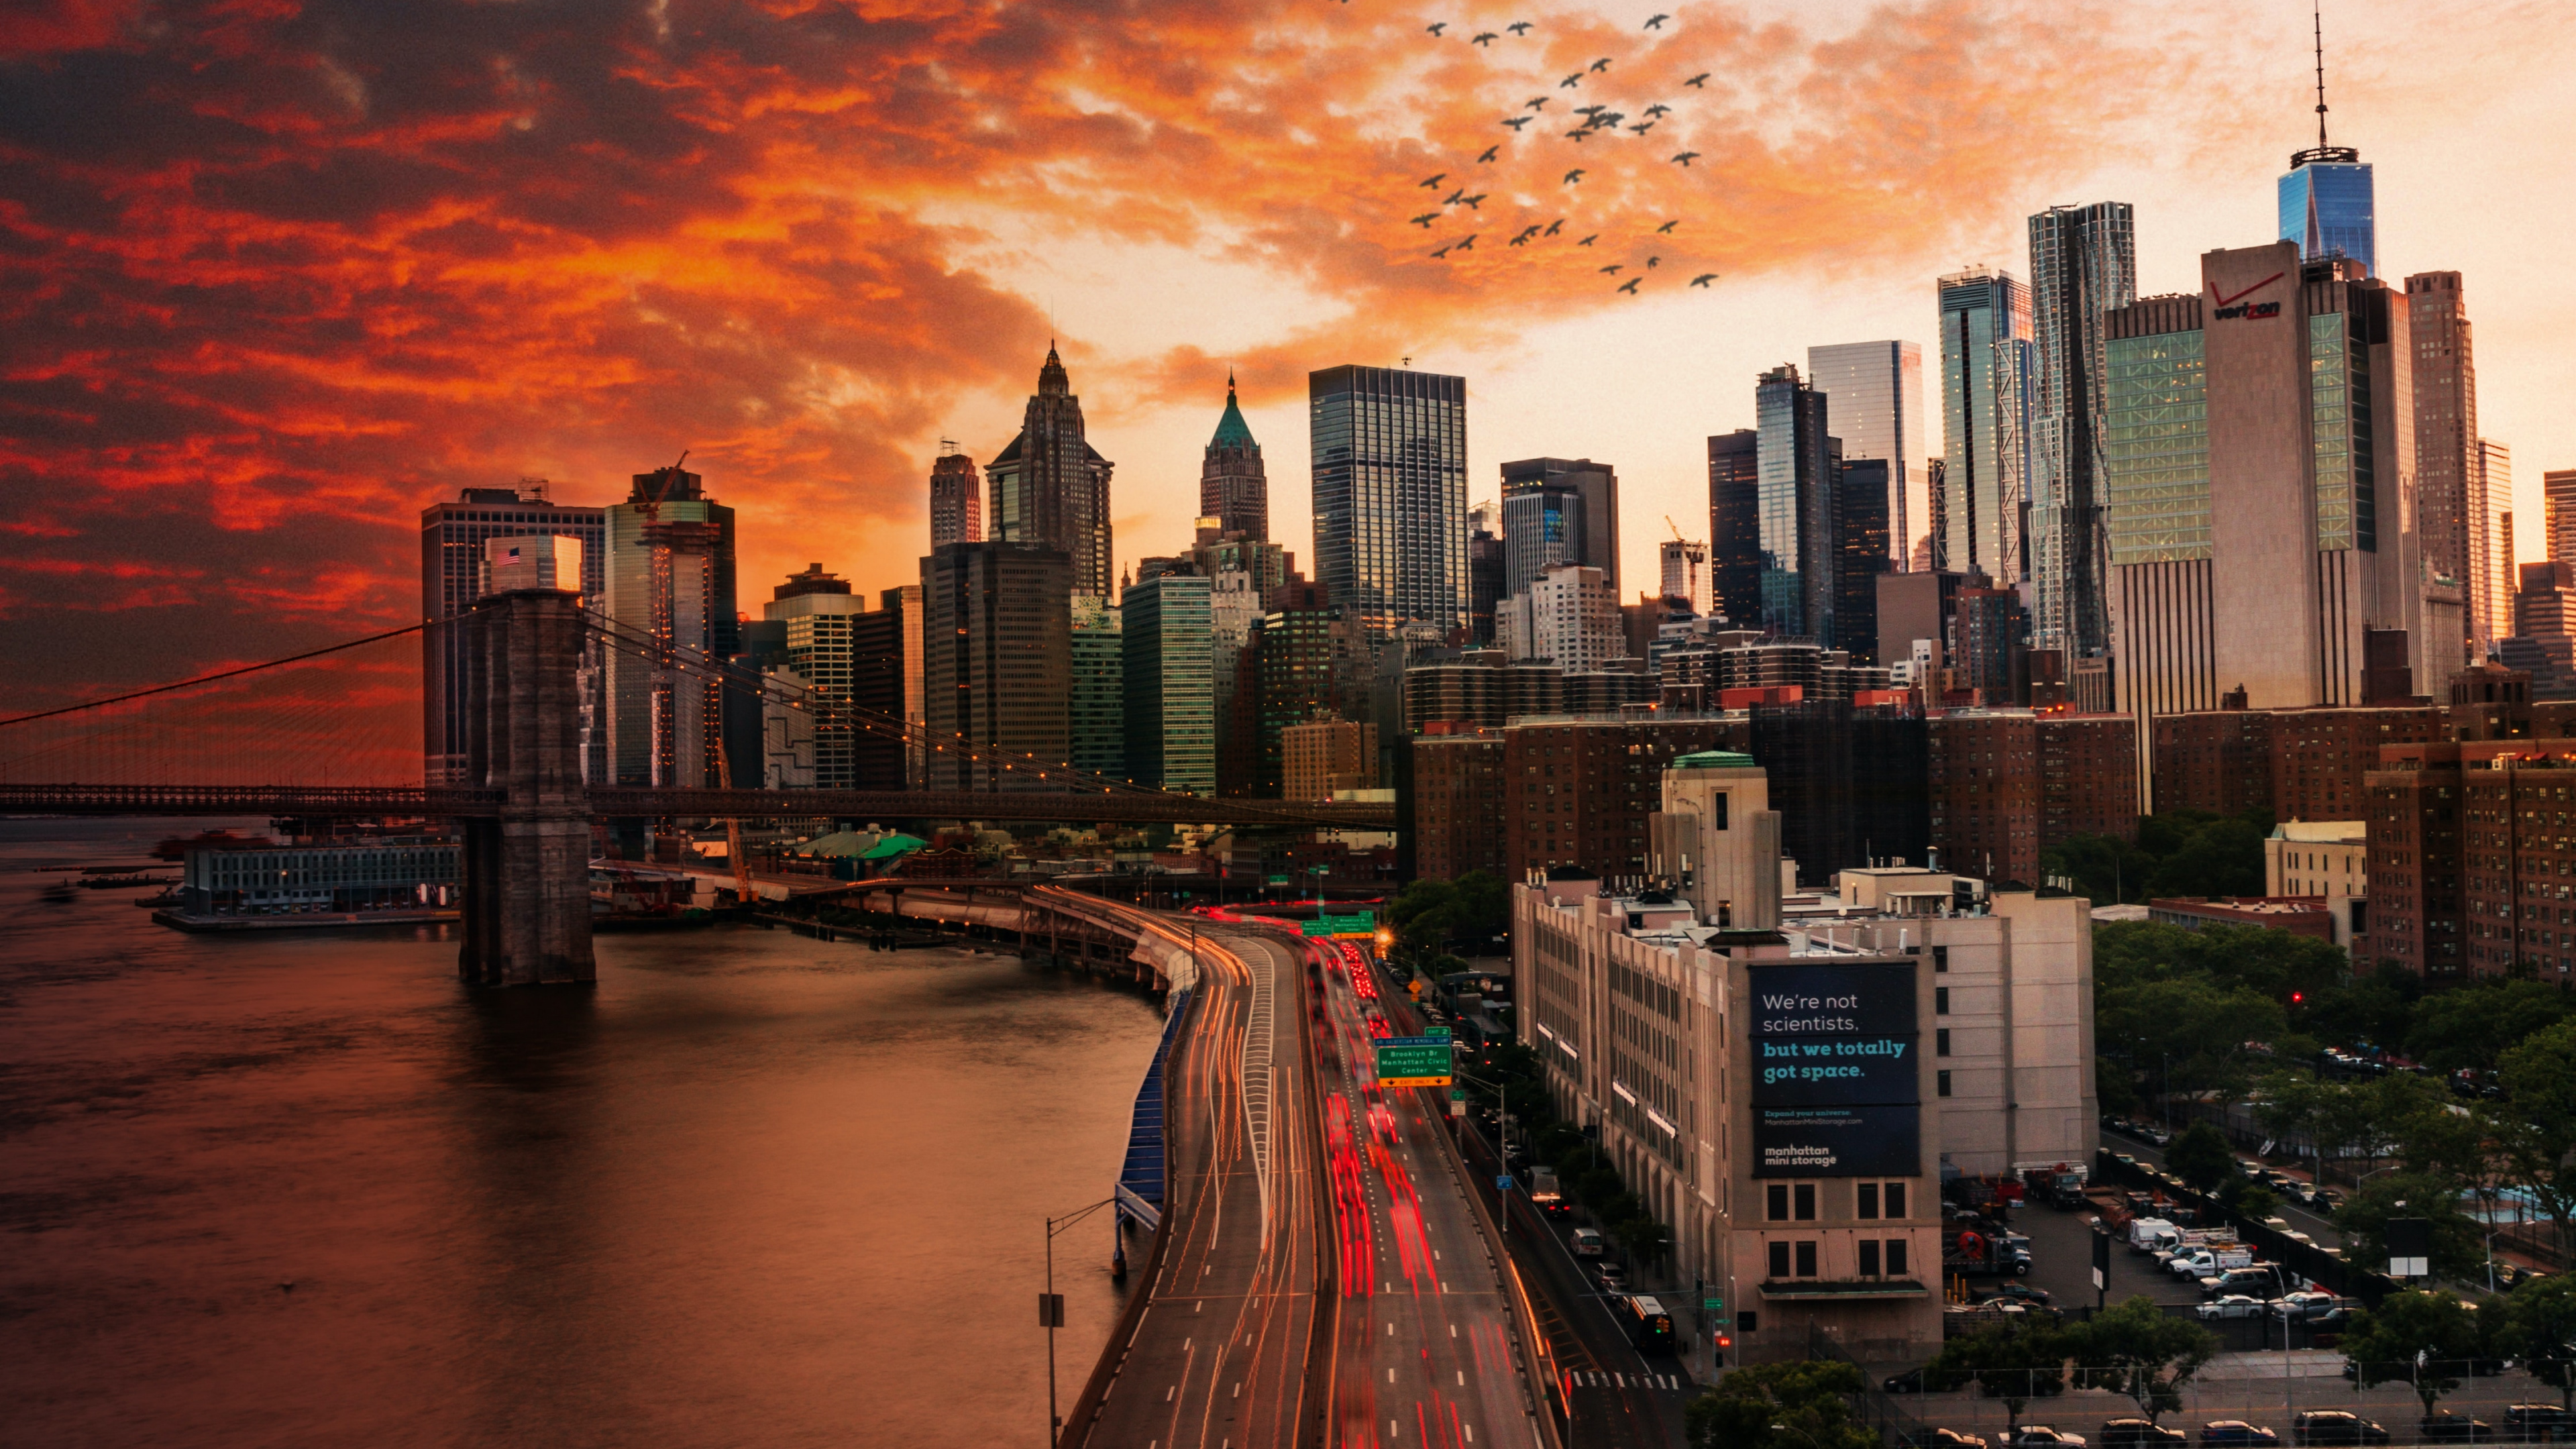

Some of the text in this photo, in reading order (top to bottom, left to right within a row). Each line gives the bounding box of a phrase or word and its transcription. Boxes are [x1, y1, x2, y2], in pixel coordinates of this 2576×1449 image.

[2214, 301, 2280, 320] verizon
[1763, 994, 1858, 1010] We're not
[1764, 1016, 1859, 1032] scientists,
[1764, 1040, 1905, 1059] but we totally
[1764, 1065, 1865, 1084] got space.
[1764, 1118, 1863, 1126] ManhattanMiniStorage.com
[1765, 1143, 1829, 1156] manhattan
[1765, 1156, 1837, 1167] mini storage
